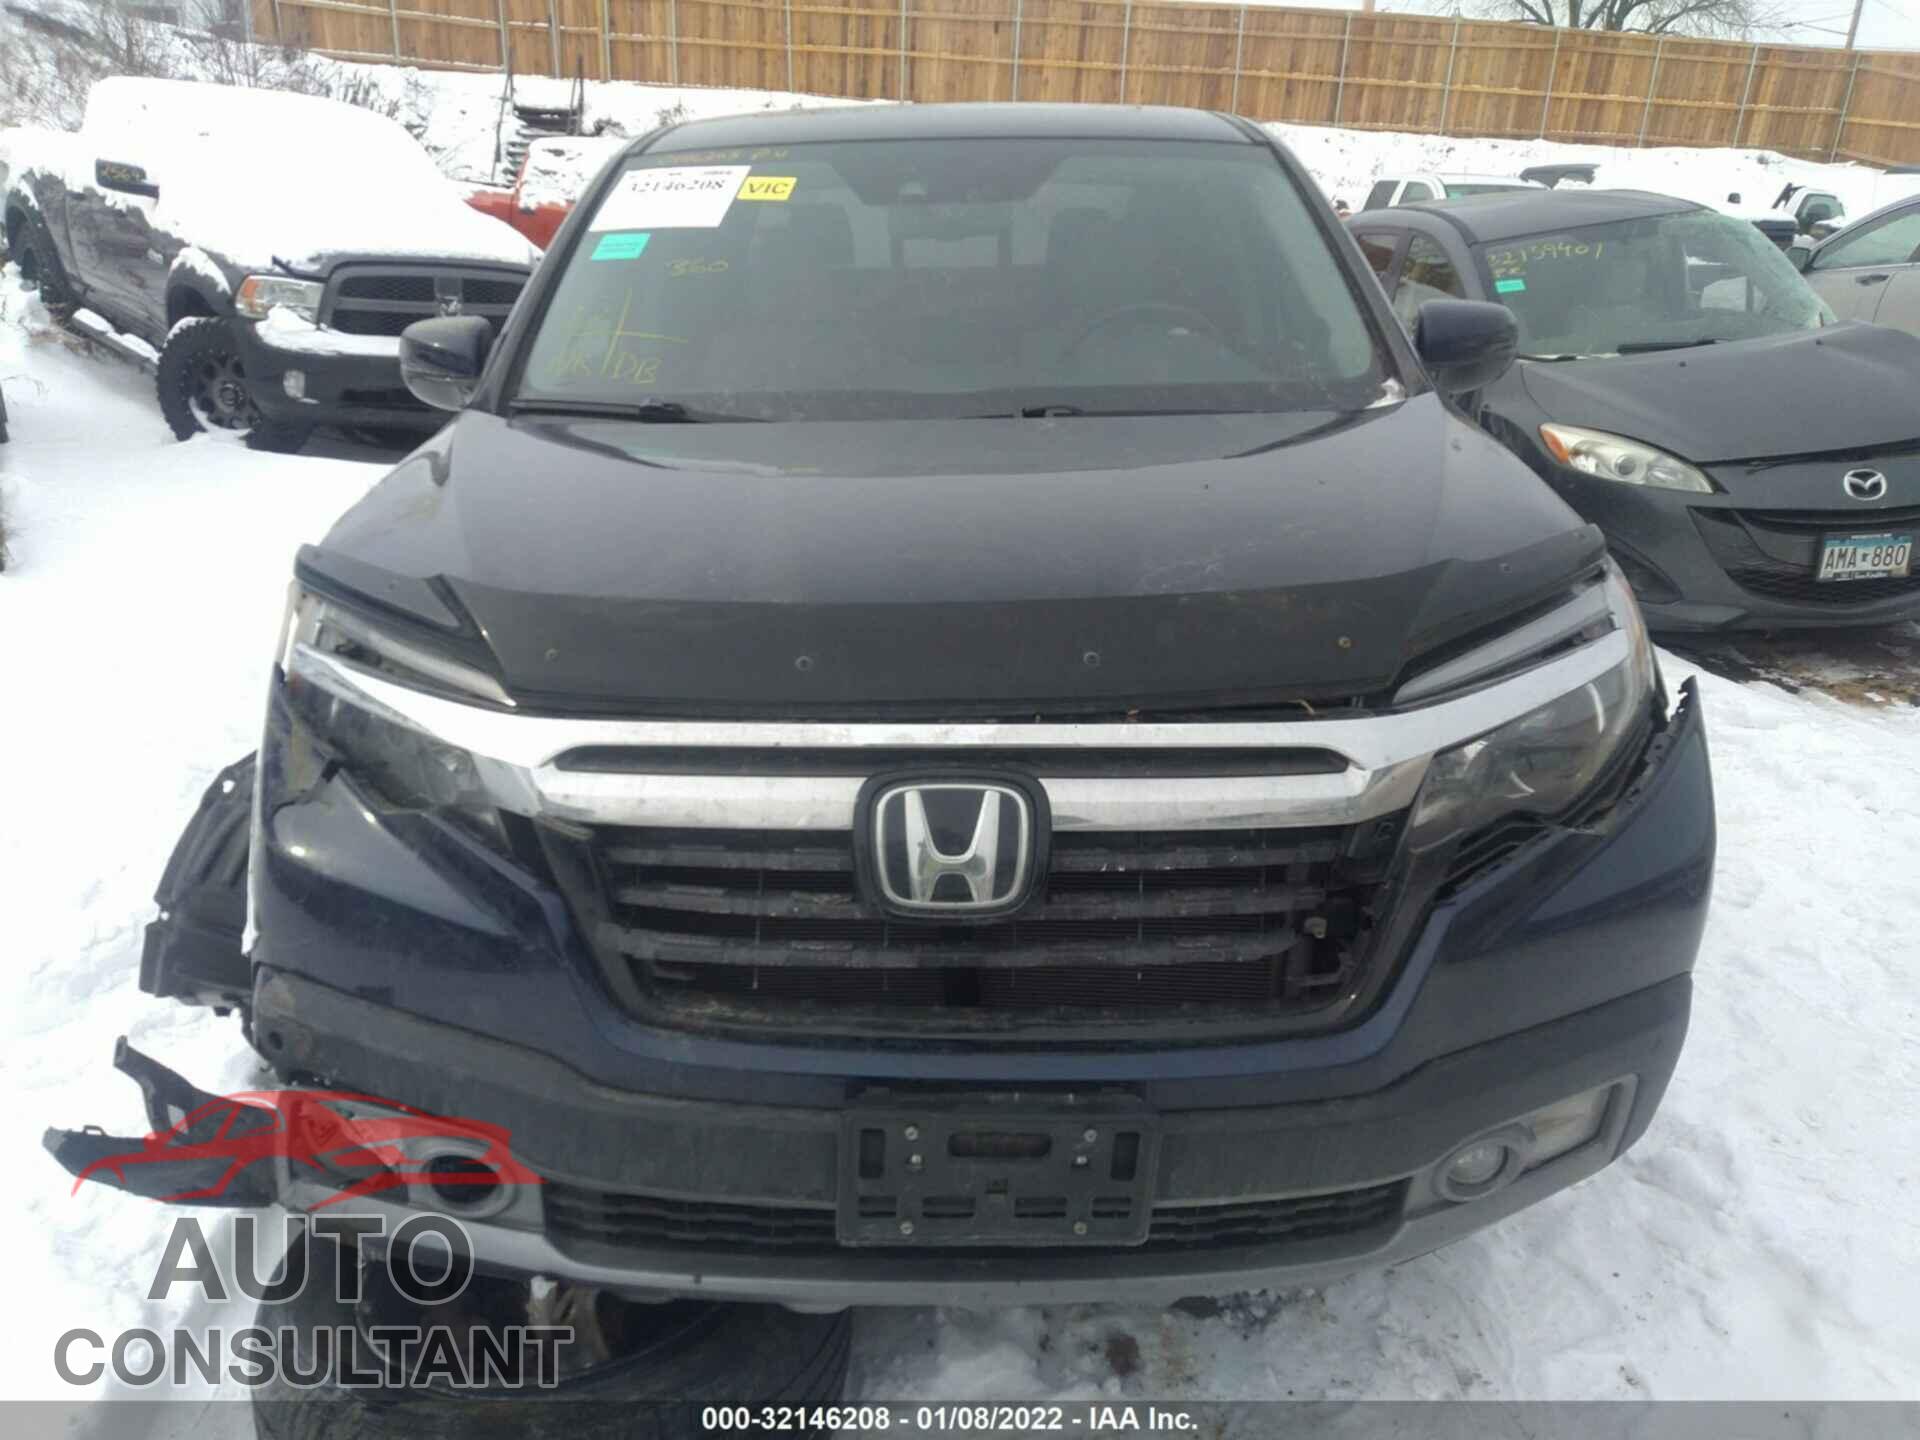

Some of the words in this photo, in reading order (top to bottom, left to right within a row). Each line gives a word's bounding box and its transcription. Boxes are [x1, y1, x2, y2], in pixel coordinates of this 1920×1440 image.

[748, 182, 790, 194] VIC
[1823, 547, 1857, 570] AMA
[1871, 545, 1906, 567] 880
